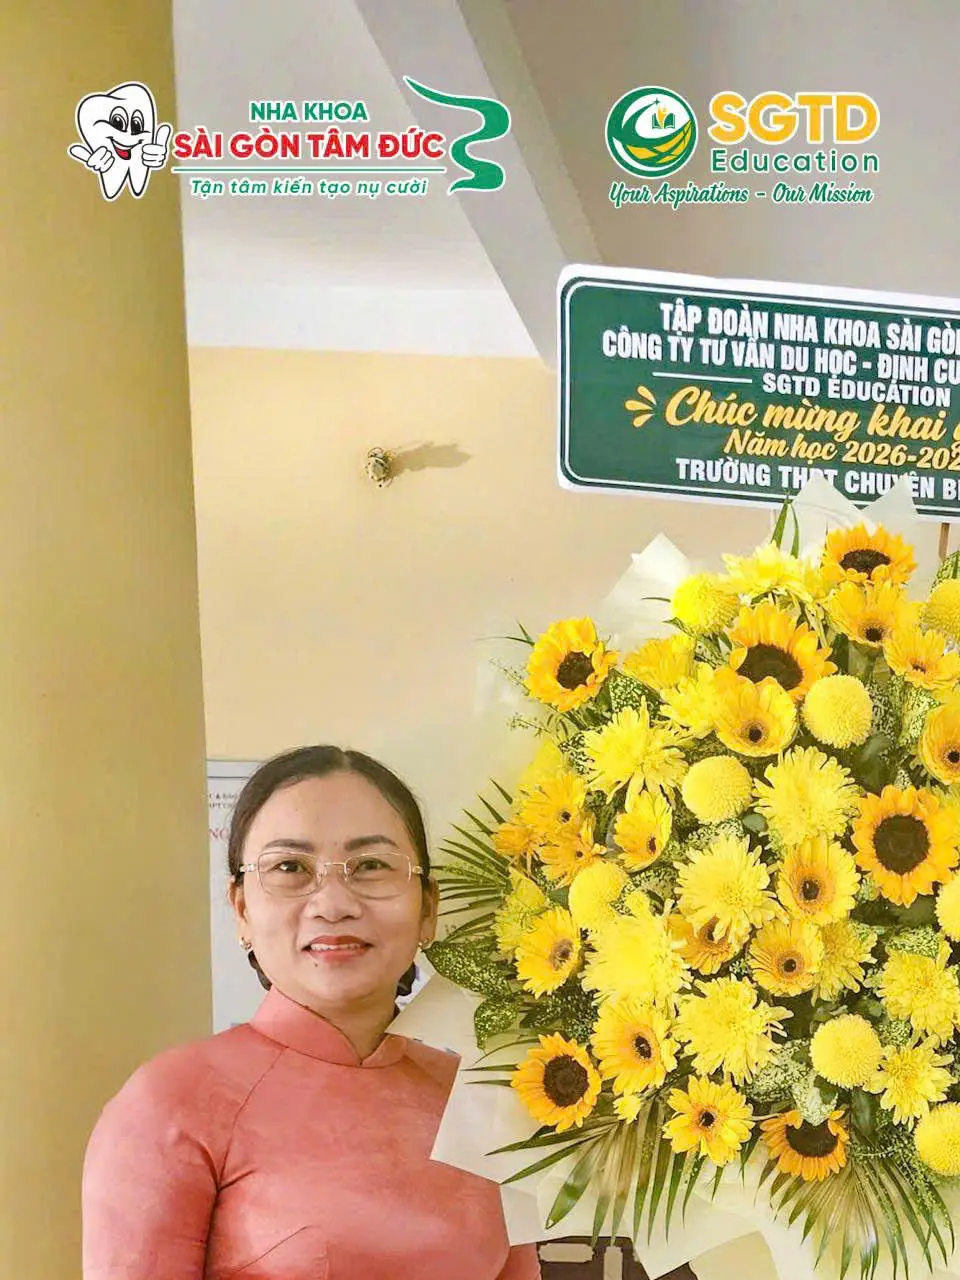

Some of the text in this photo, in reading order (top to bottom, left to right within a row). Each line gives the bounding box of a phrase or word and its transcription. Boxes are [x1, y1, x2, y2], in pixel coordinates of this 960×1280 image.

[660, 298, 702, 336] TẬP
[707, 303, 768, 339] ĐOÀN
[774, 313, 818, 343] NHA
[824, 318, 881, 349] KHOA
[886, 318, 922, 352] SÀI
[602, 325, 663, 361] CÔNG
[699, 338, 728, 366] TƯ
[781, 345, 809, 372] DU
[815, 347, 857, 378] HỌC
[877, 353, 929, 385] ĐỊNH
[664, 386, 759, 427] Chúc
[762, 399, 861, 442] mừng
[866, 404, 949, 441] khai
[762, 373, 950, 407] SGTD EDUCATION
[723, 429, 788, 459] Năm
[790, 434, 837, 463] học
[676, 457, 771, 487] TRƯỜNG
[845, 470, 935, 499] CHUÊN
